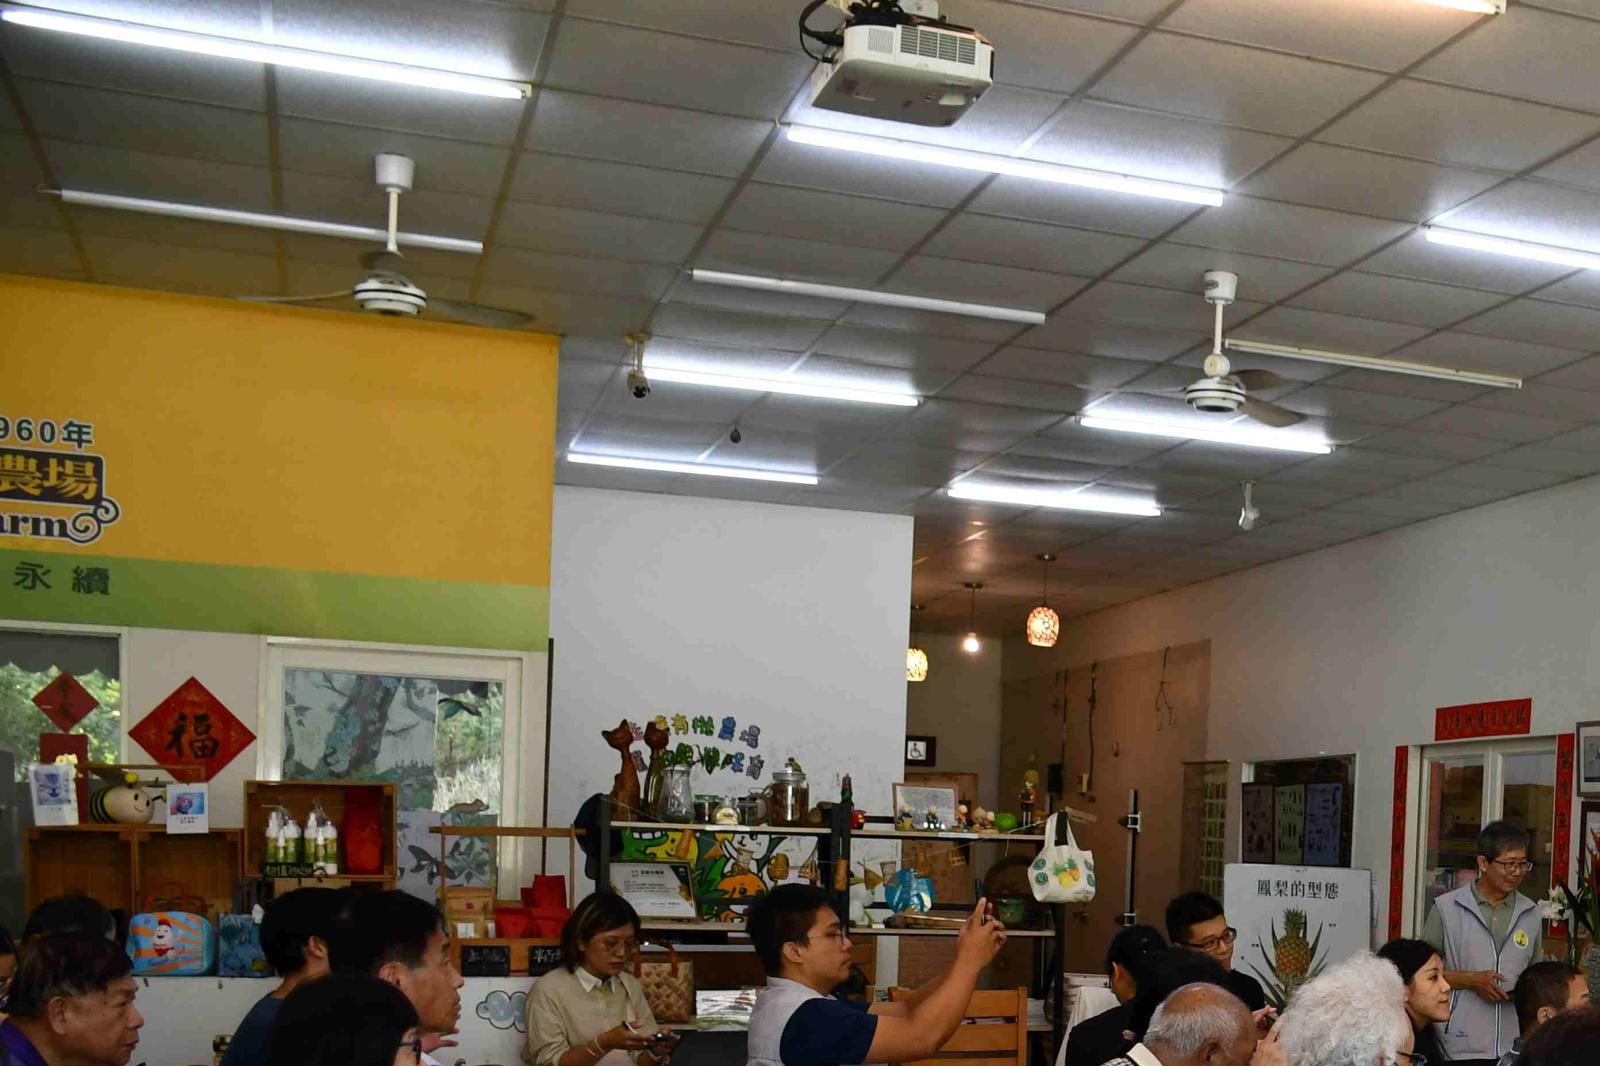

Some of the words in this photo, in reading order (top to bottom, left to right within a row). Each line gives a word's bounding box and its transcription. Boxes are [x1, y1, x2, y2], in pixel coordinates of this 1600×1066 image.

[166, 711, 219, 759] 福
[1256, 879, 1339, 900] 鳳梨的型態
